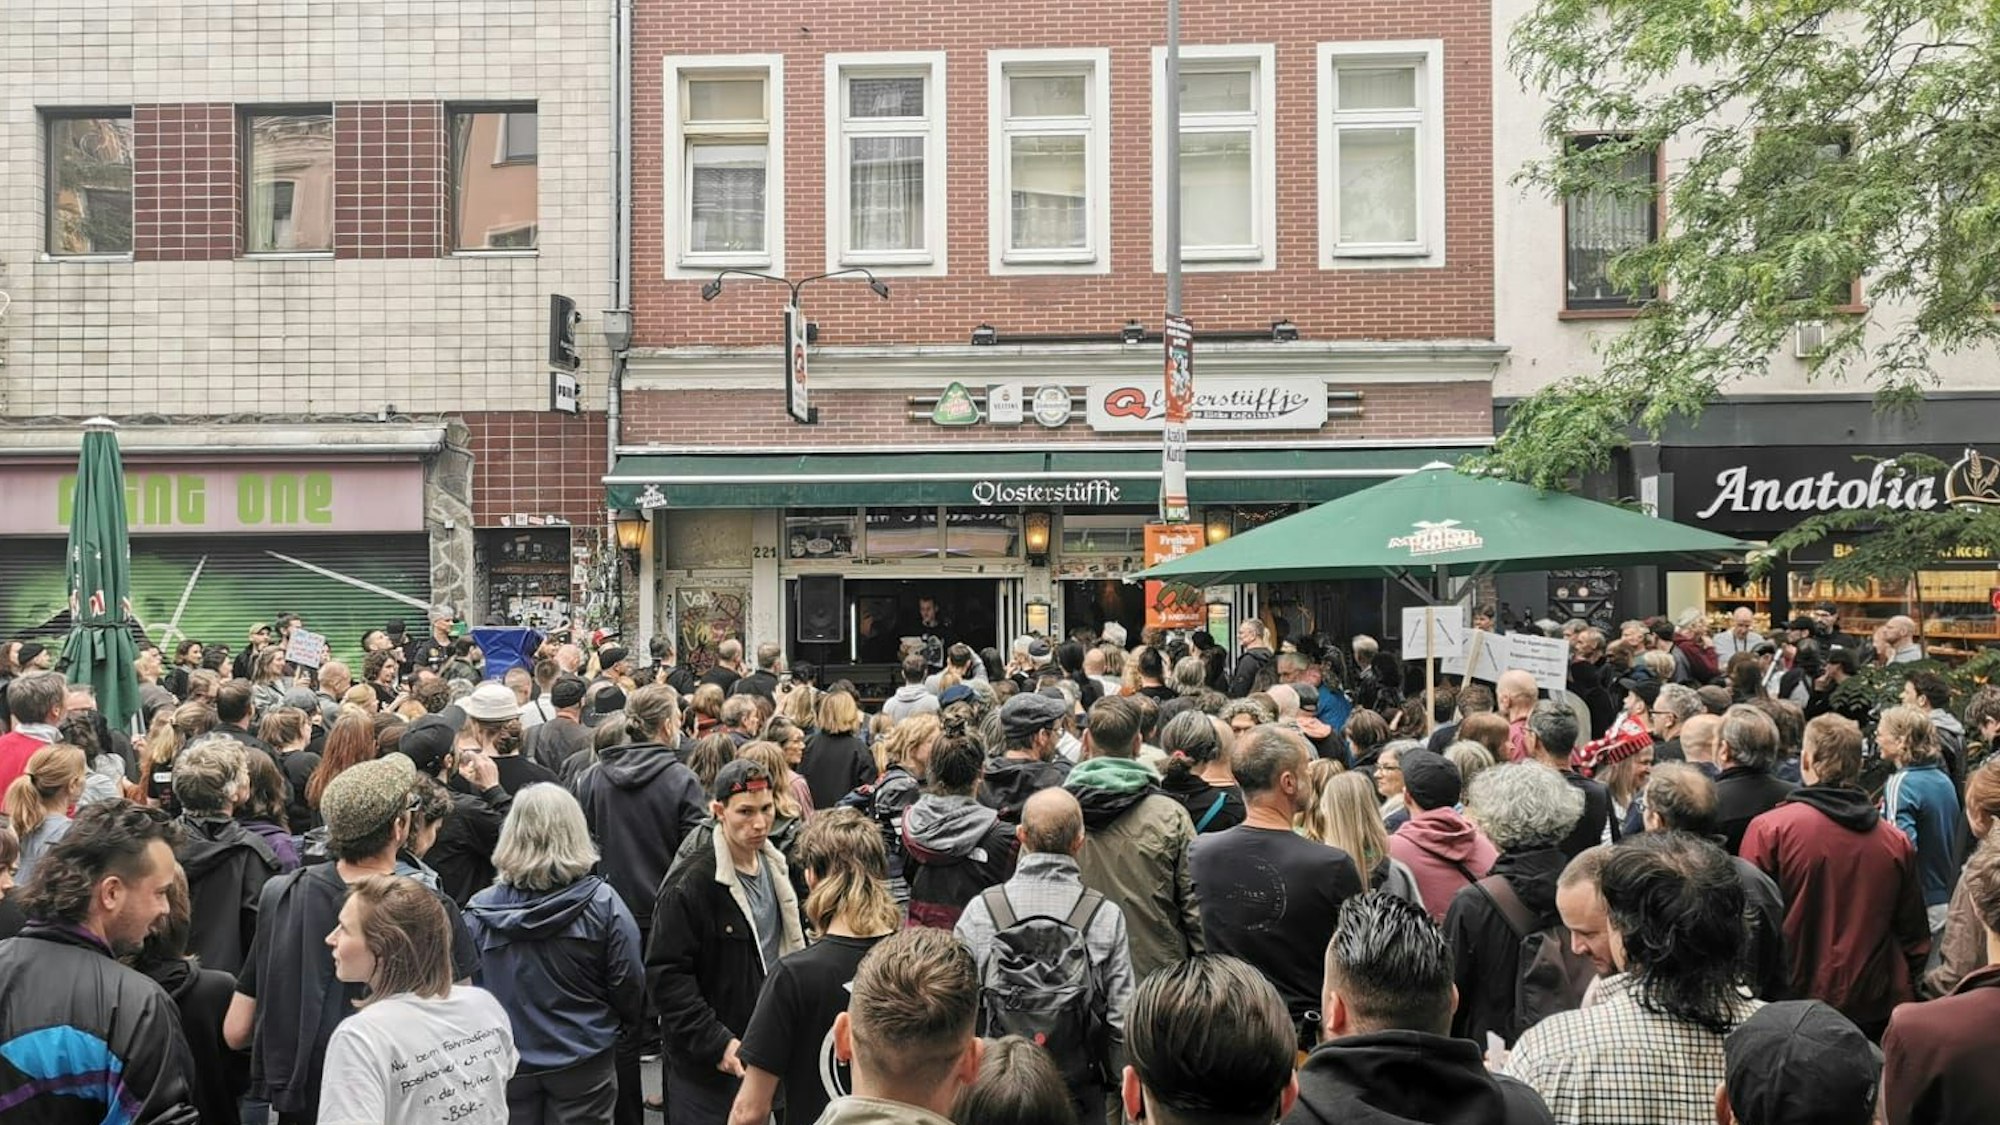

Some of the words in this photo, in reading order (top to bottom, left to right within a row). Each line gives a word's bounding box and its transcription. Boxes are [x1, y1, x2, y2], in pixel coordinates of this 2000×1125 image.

[1104, 387, 1304, 419] Qlerstüffje
[972, 479, 1122, 506] Qlosterstüffje
[1696, 458, 1938, 520] Anatolia
[752, 546, 777, 558] 221
